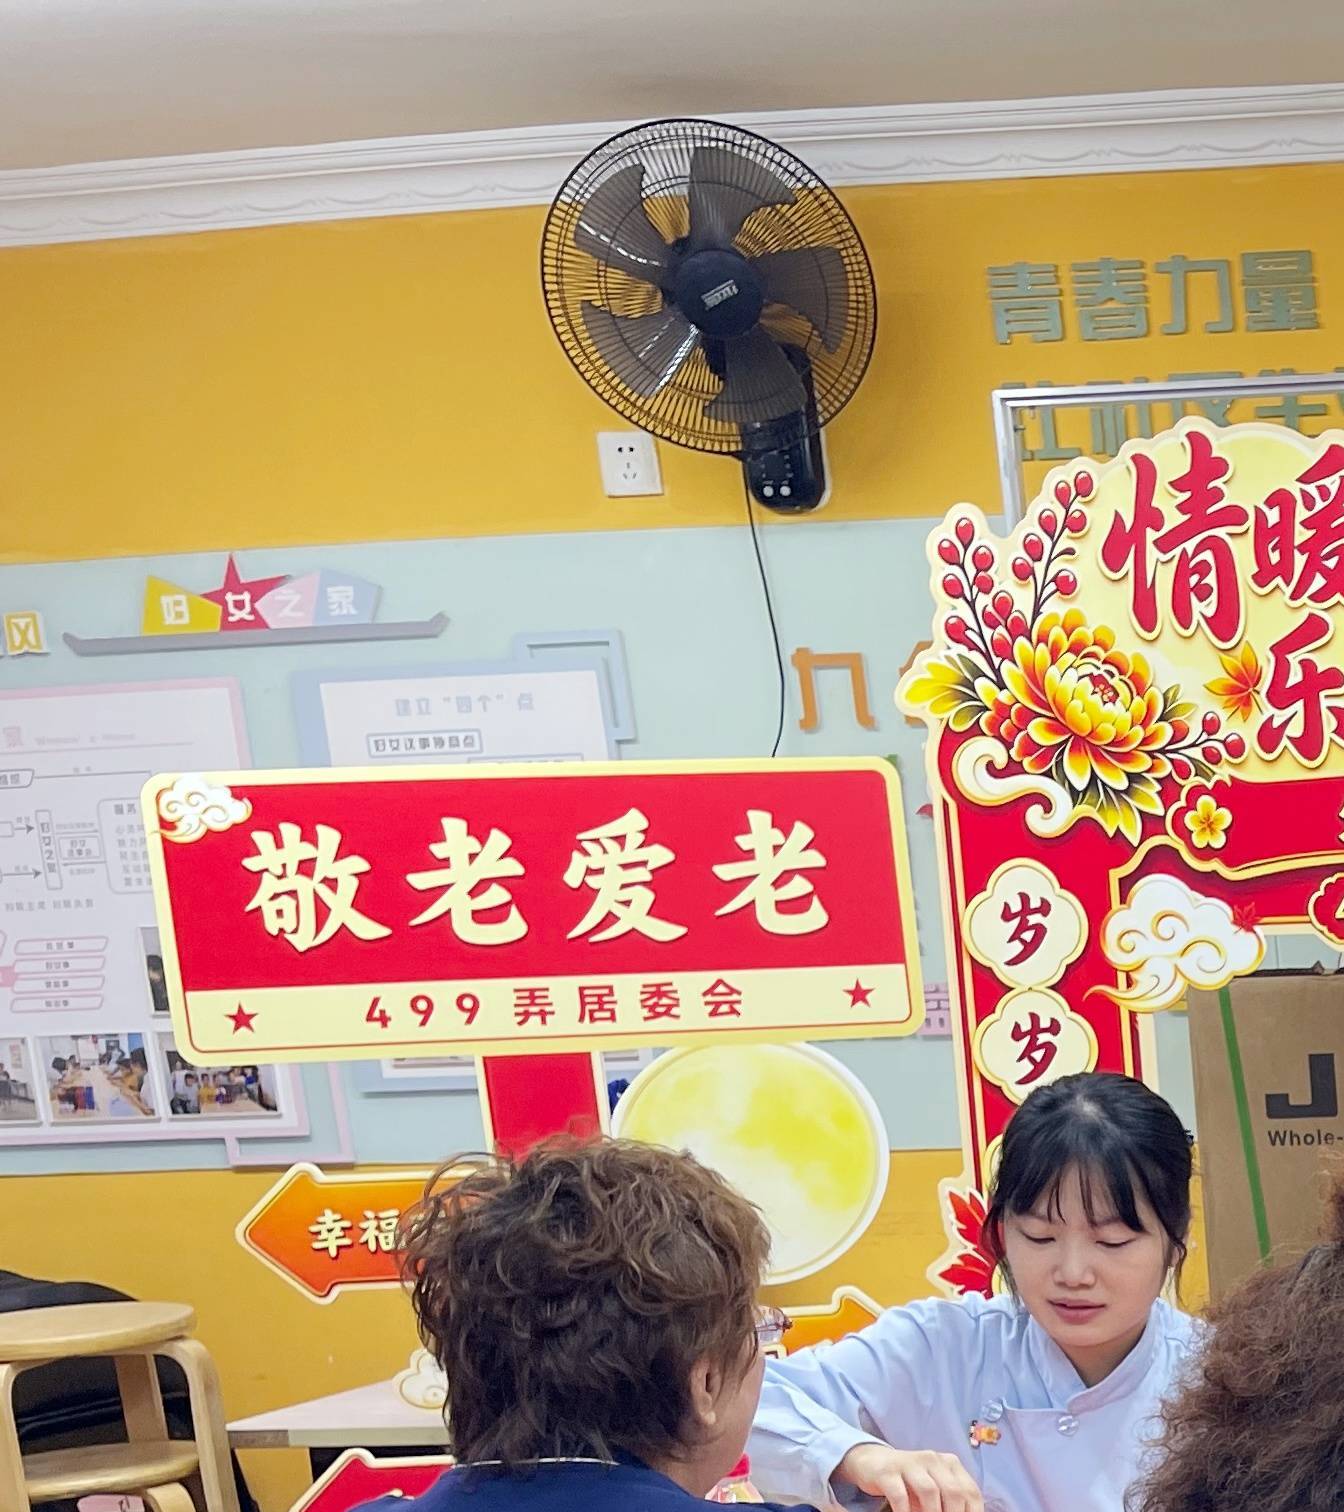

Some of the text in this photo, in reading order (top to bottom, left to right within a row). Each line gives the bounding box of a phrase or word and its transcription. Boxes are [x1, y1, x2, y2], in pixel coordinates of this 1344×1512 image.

[987, 250, 1321, 344] 青春力量
[160, 584, 359, 626] 妇女之家
[241, 808, 829, 952] 敬老爱老
[365, 978, 744, 1029] 499弄居委会
[308, 1209, 446, 1258] 幸福
